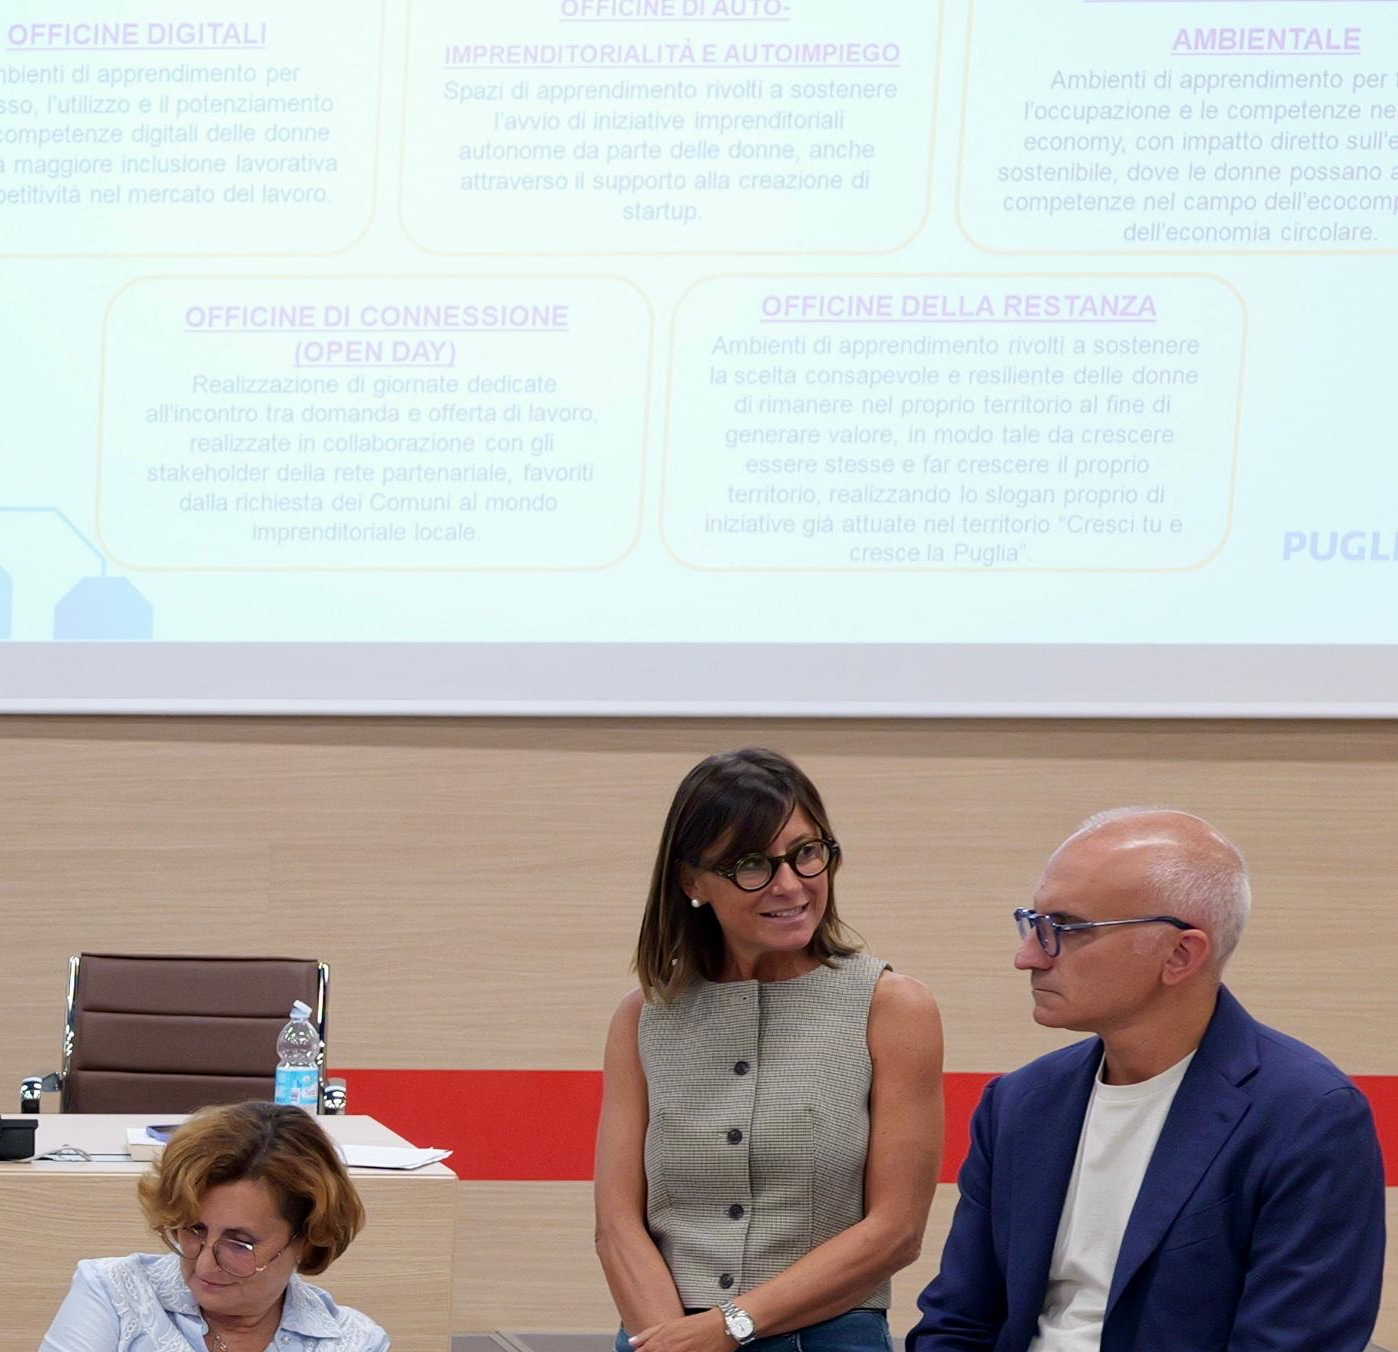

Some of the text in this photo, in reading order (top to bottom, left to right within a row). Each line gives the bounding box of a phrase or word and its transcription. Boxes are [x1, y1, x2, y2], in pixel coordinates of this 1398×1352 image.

[7, 21, 267, 47] OFFICINE DIGITALI
[1171, 26, 1362, 51] AMBIENTALE
[445, 37, 901, 65] IMPRENDITORIALITÀ E AUTOIMPIEGO
[70, 63, 91, 85] di
[96, 63, 257, 89] apprendimento
[265, 66, 301, 88] per
[443, 79, 898, 106] Spazi di apprendimento rivolti a sostenere
[137, 97, 153, 115] e
[158, 93, 170, 114] il
[175, 93, 335, 119] potenziamento
[130, 123, 199, 149] digitali
[205, 122, 257, 144] delle
[263, 123, 331, 143] donne
[566, 111, 586, 131] di
[592, 110, 686, 131] iniziative
[693, 109, 845, 136] imprenditoriali
[458, 139, 876, 165] autonome da parte delle donne, anche
[13, 154, 114, 180] maggiore
[120, 153, 227, 174] inclusione
[235, 153, 339, 174] lavorativa
[89, 184, 122, 205] nel
[127, 184, 216, 205] mercato
[222, 183, 255, 204] del
[261, 183, 331, 204] lavoro.
[460, 169, 871, 196] attraverso il supporto alla creazione di
[621, 200, 703, 227] startup.
[185, 304, 569, 328] OFFICINE DI CONNESSIONE
[760, 294, 1158, 318] OFFICINE DELLA RESTANZA
[294, 339, 457, 364] (OPEN DAY)
